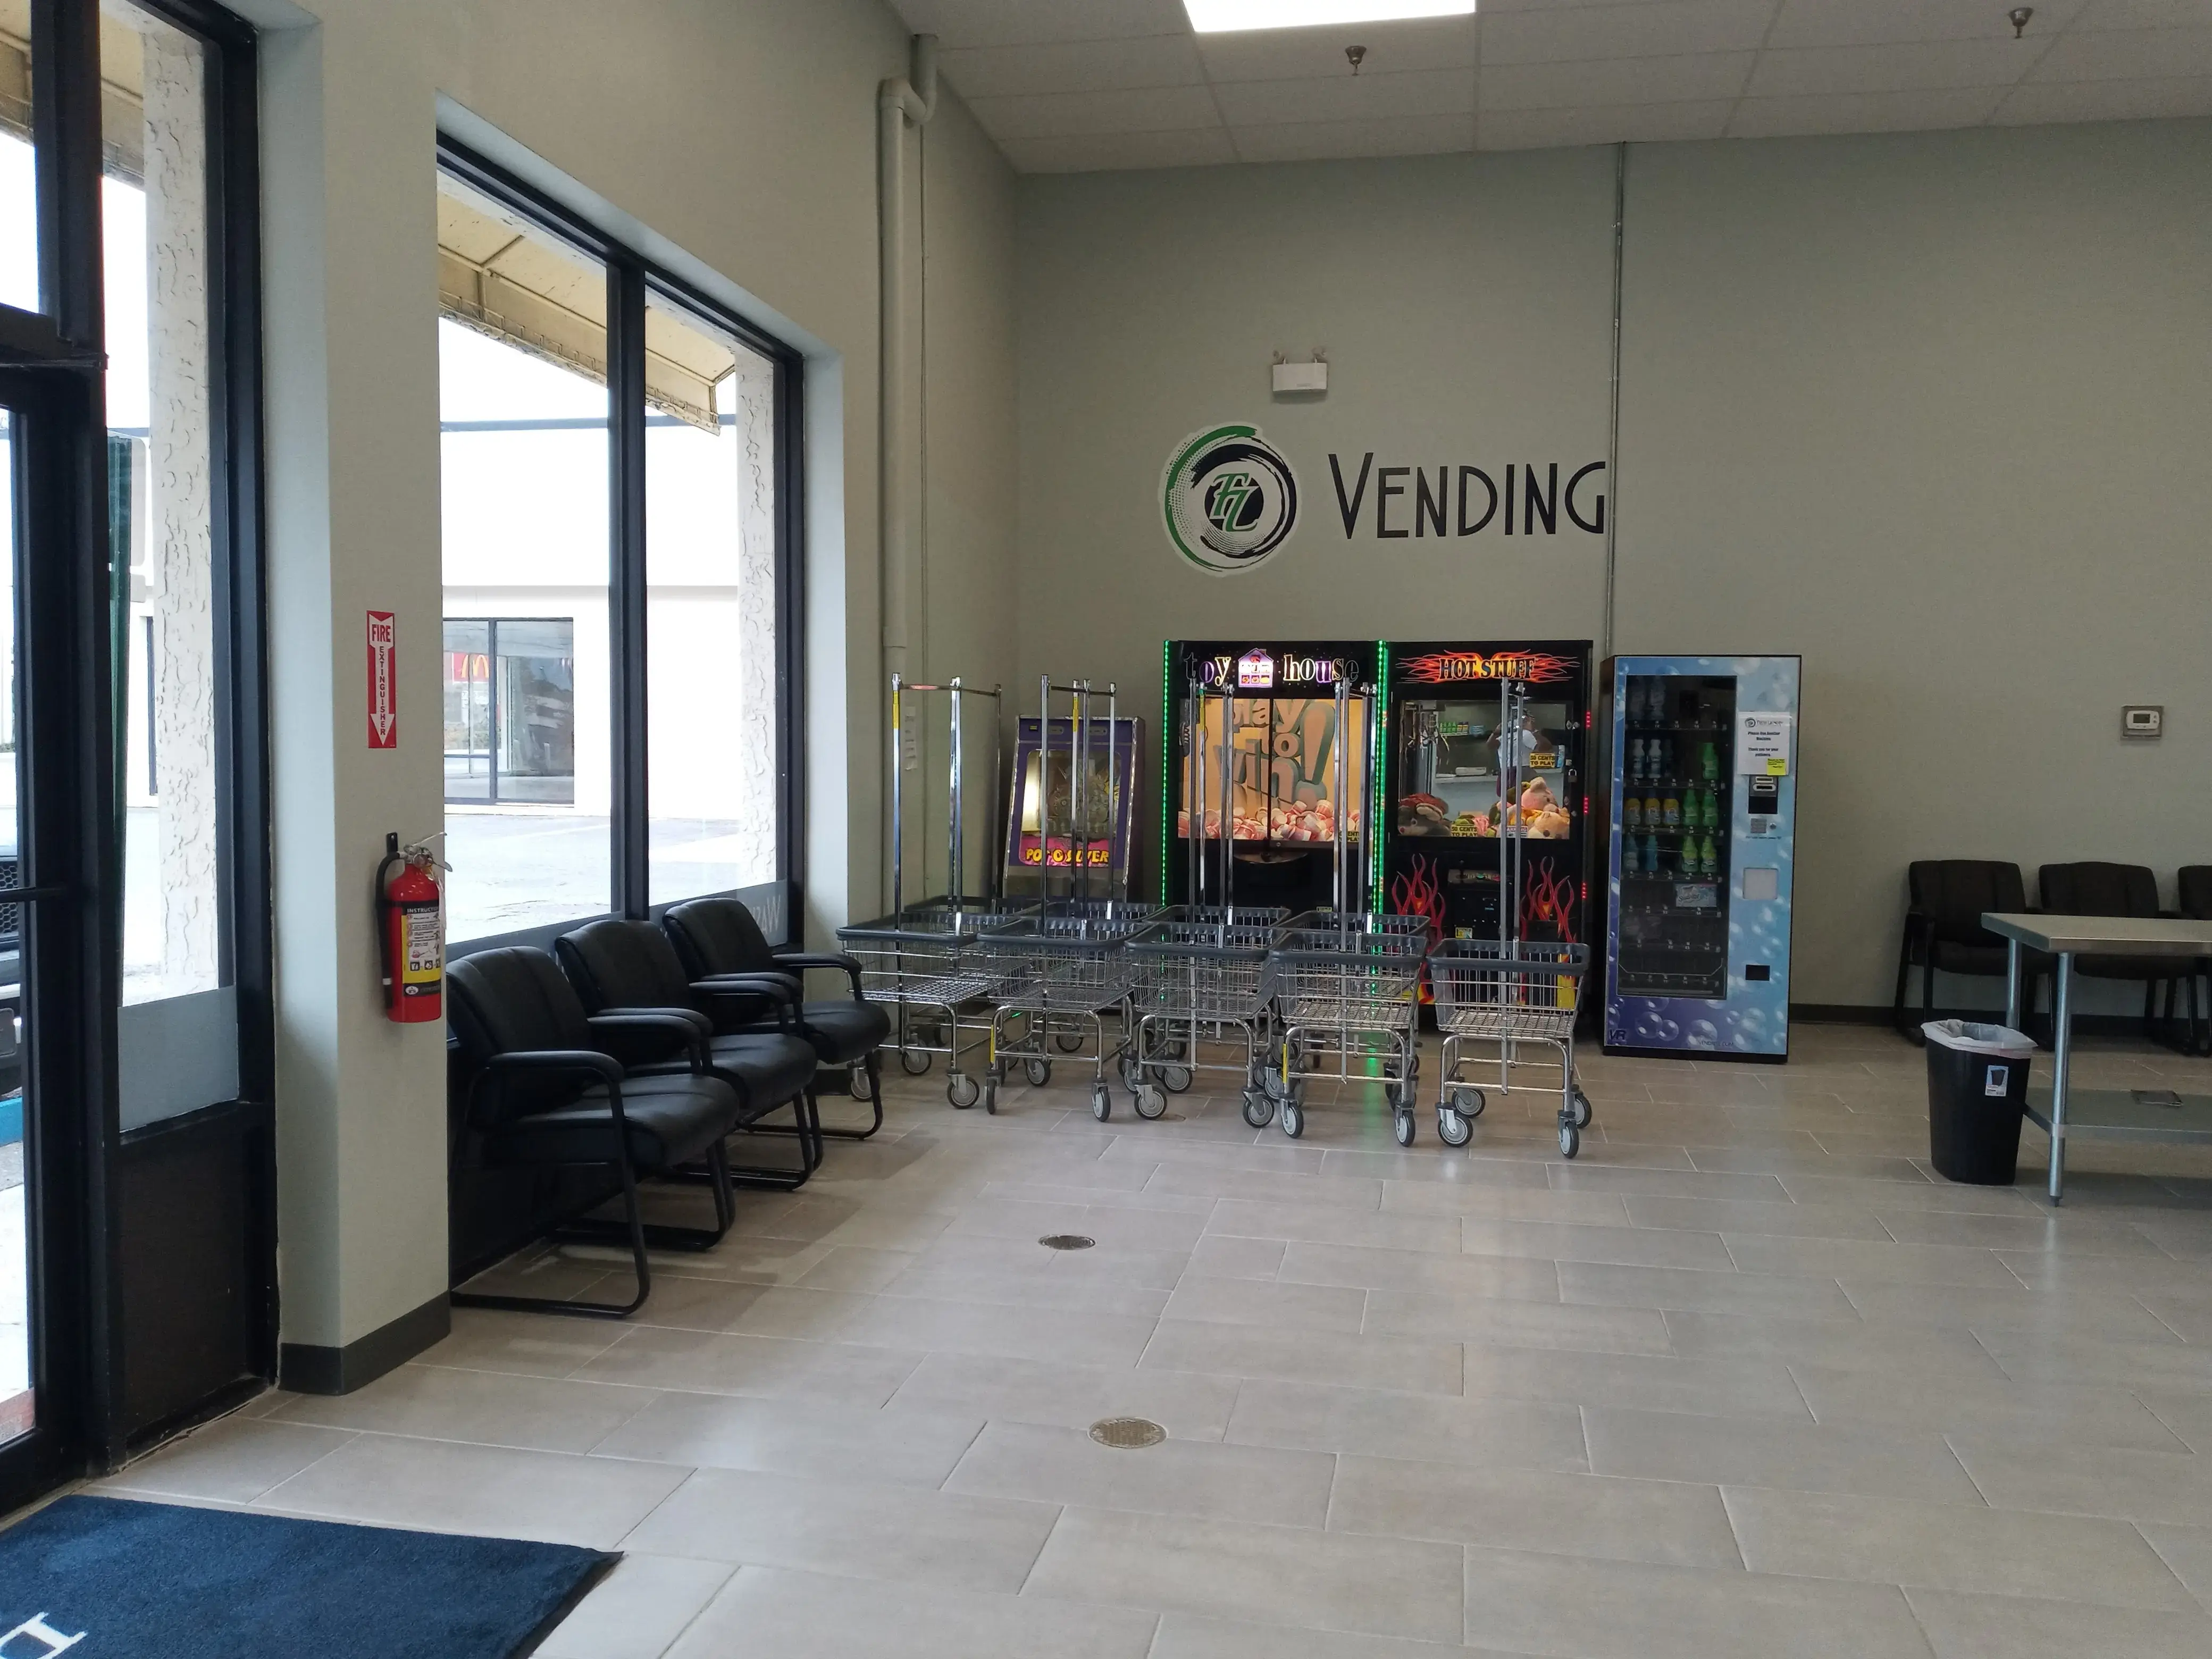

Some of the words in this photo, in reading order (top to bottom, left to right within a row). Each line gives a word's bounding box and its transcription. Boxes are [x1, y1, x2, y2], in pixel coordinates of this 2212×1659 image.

[1328, 452, 1606, 540] VENDING
[372, 624, 391, 643] FIRE
[1184, 651, 1231, 687] toy
[1283, 653, 1359, 684] house
[1439, 658, 1477, 680] HOT
[1480, 657, 1536, 680] STUFF
